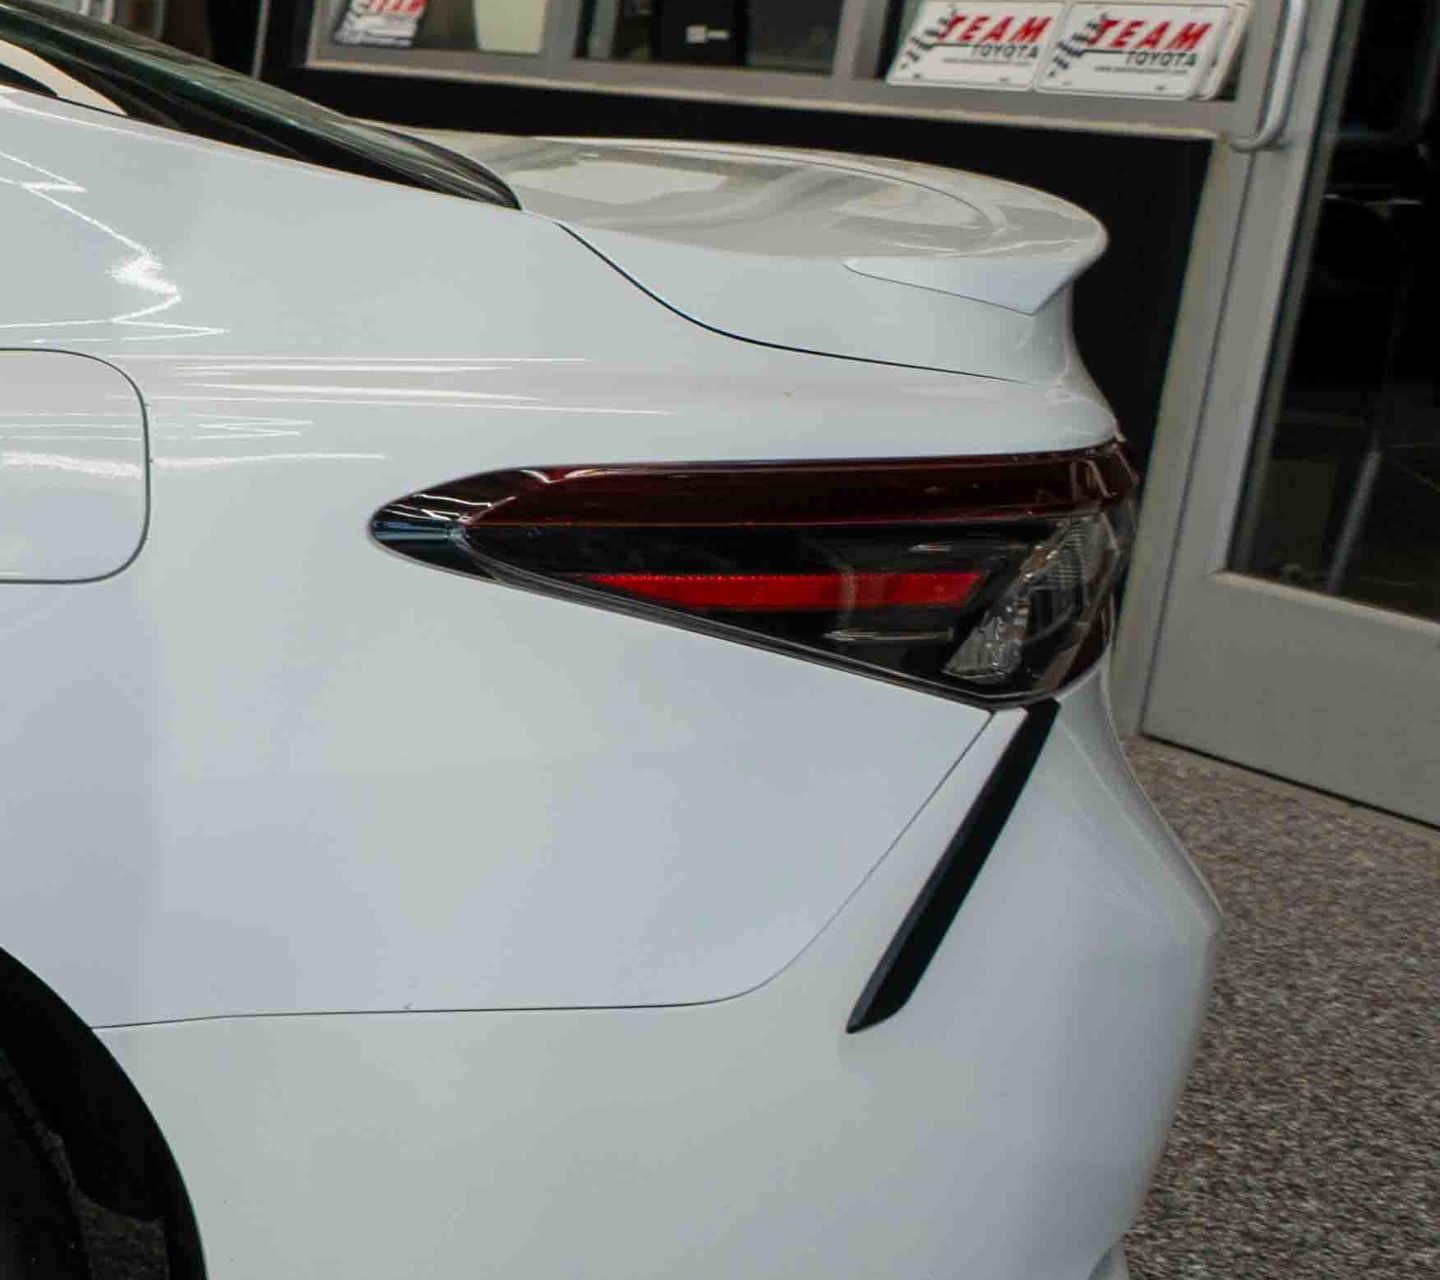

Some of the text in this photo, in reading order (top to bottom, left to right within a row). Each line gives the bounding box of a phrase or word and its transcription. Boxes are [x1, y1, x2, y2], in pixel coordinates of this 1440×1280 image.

[939, 15, 1053, 43] TEAM
[1085, 19, 1213, 50] TEAM
[970, 44, 1038, 60] TOYOTA
[1123, 50, 1197, 67] TOYOTA
